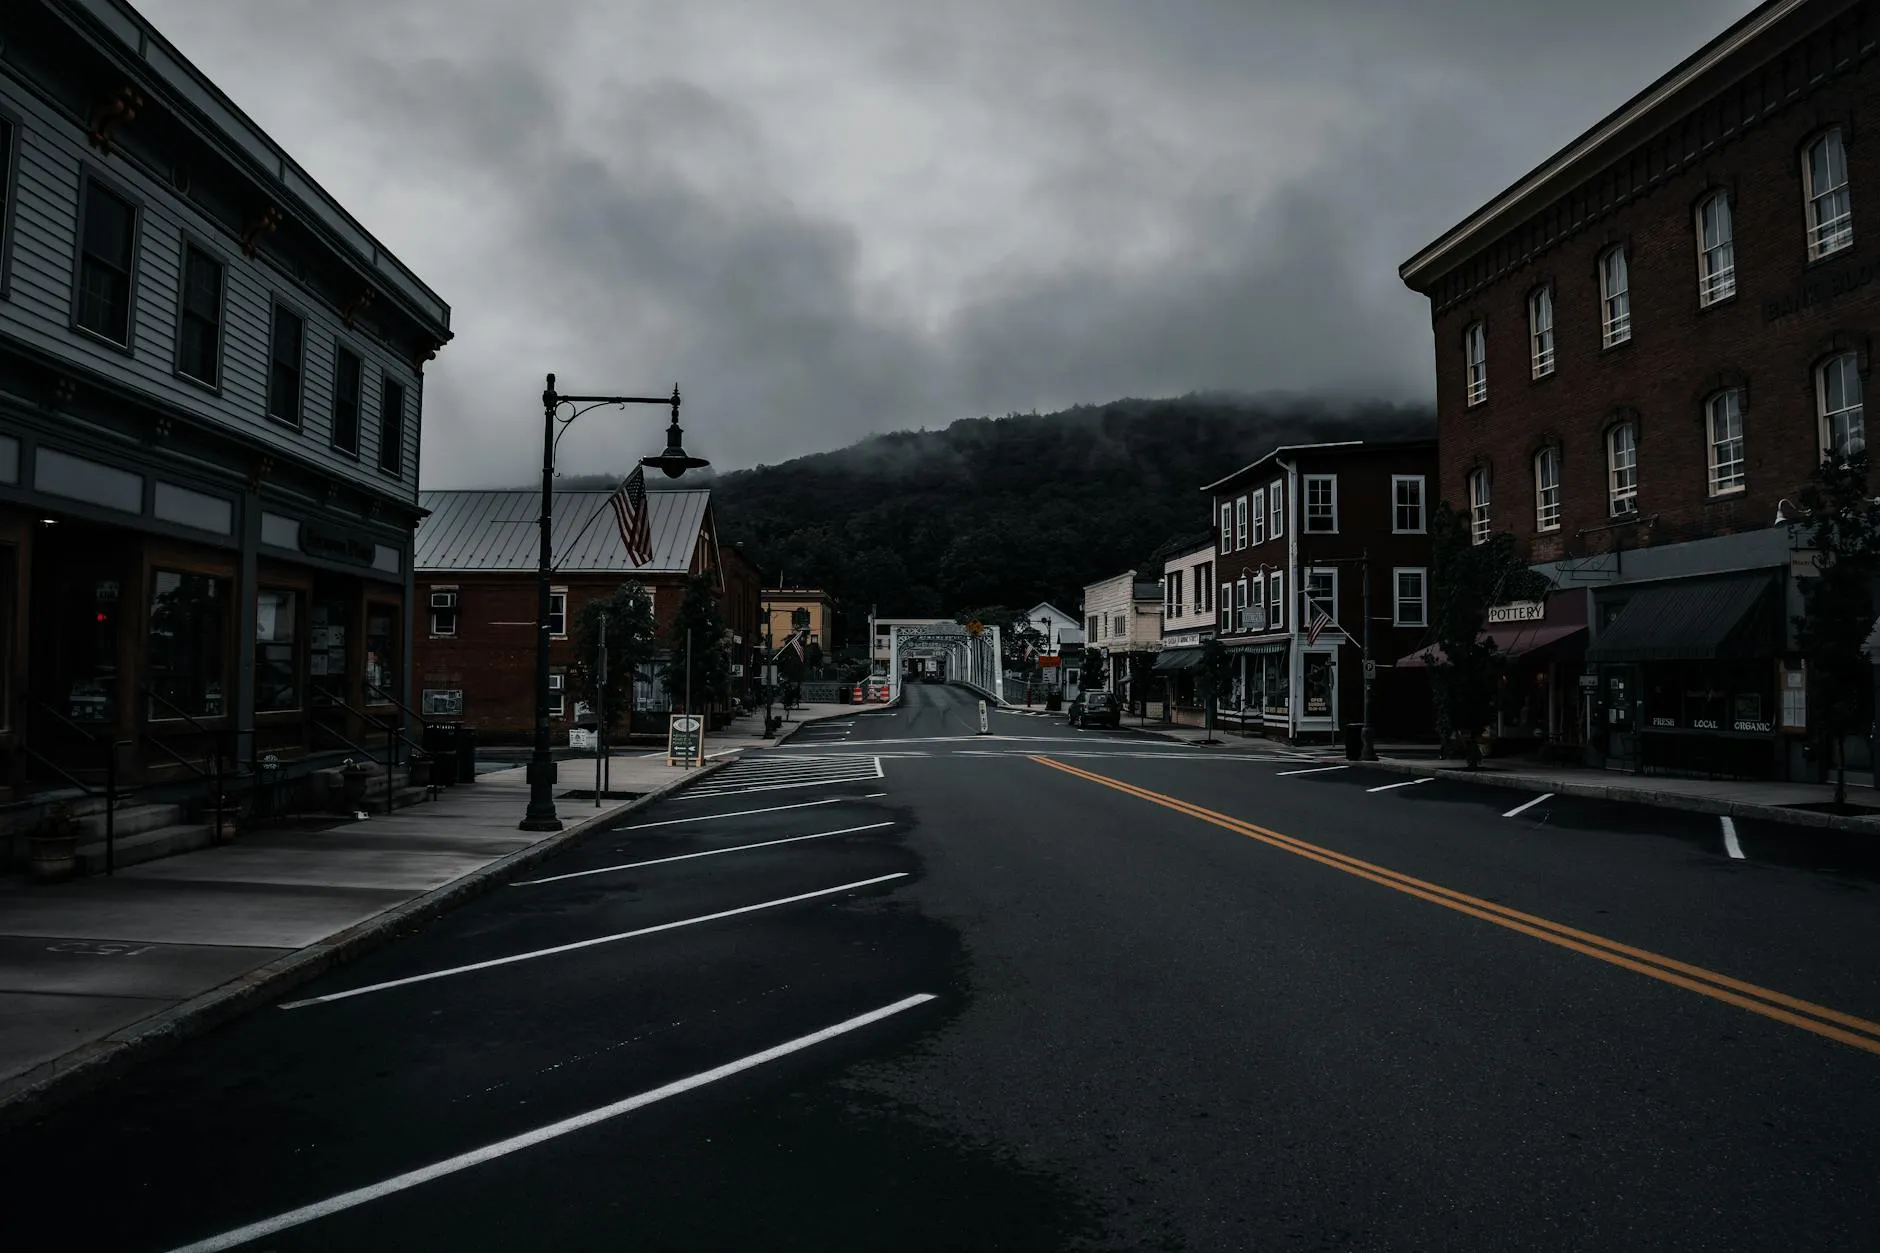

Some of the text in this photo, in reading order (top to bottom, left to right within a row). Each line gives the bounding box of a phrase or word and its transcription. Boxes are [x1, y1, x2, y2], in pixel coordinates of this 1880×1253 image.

[1831, 262, 1880, 298] BLO
[1490, 605, 1542, 621] POTTERY
[1652, 716, 1675, 728] FRESH
[1693, 719, 1719, 730] LOCAL
[1733, 720, 1771, 732] ORGANIC
